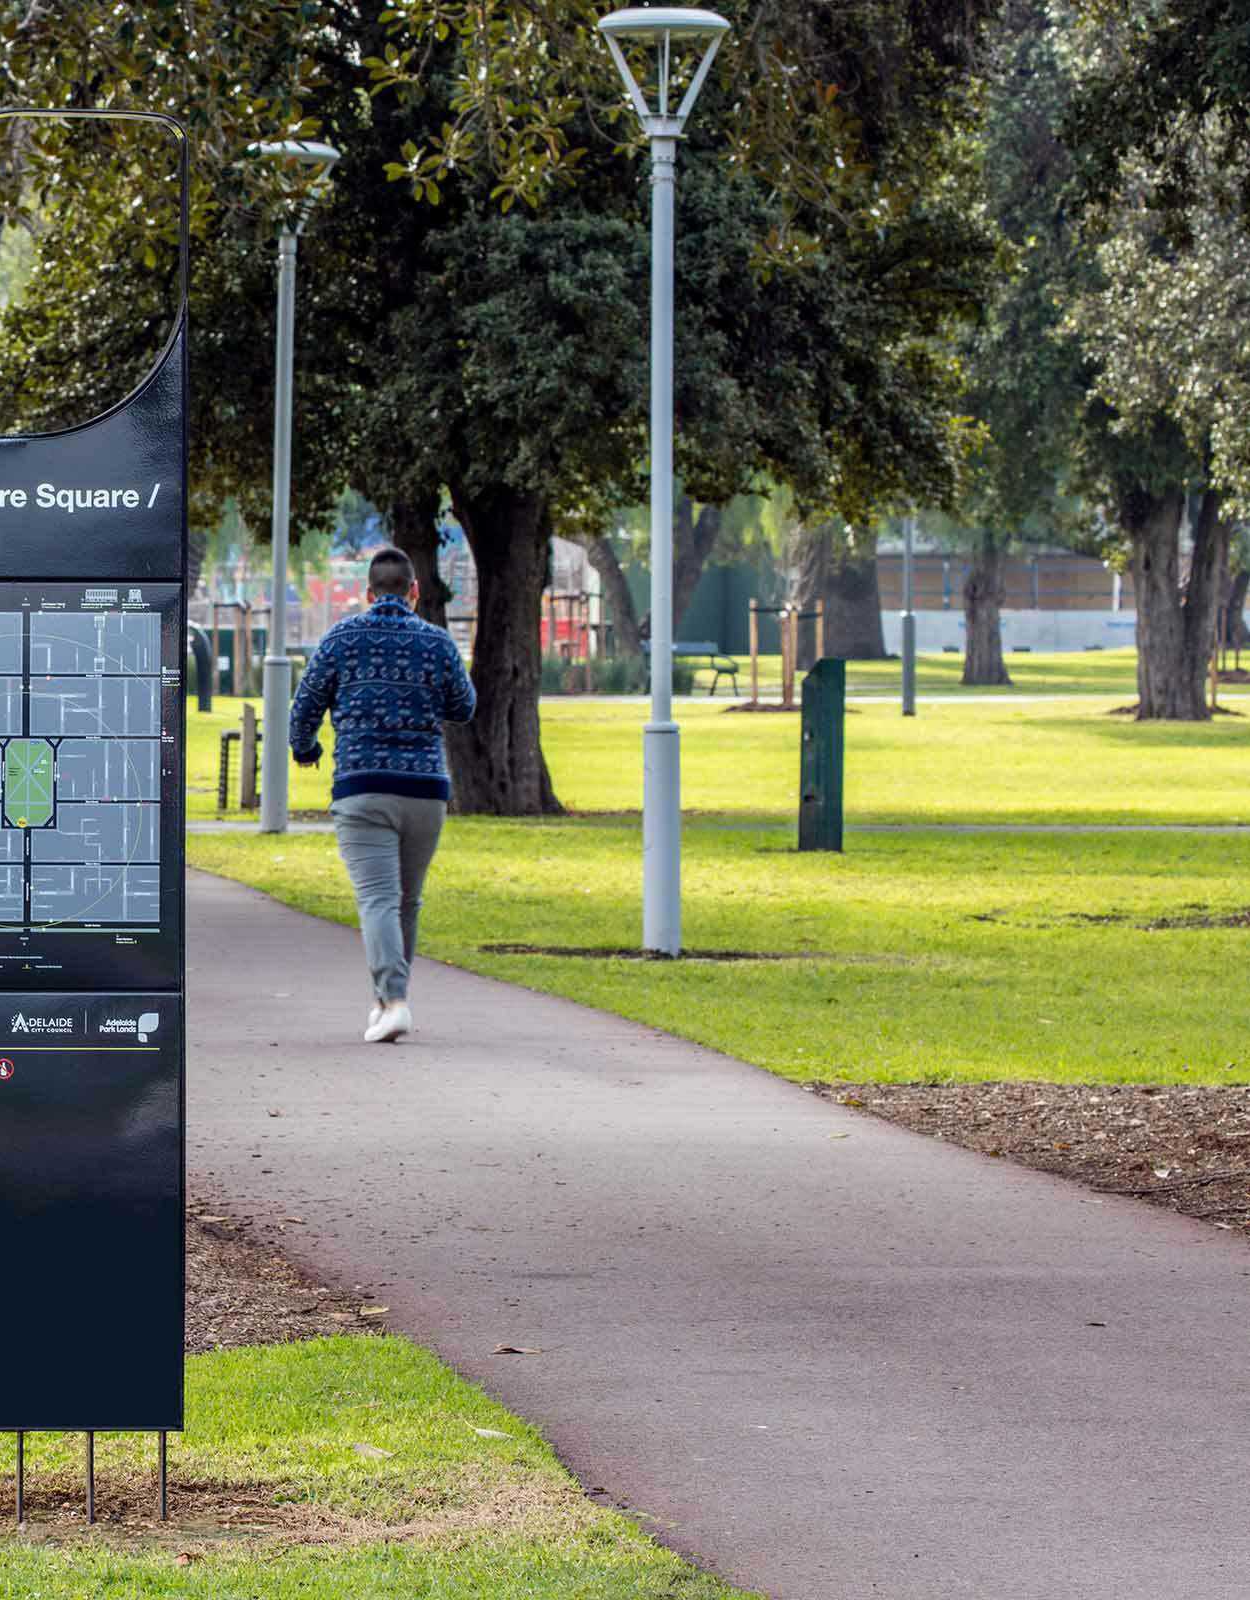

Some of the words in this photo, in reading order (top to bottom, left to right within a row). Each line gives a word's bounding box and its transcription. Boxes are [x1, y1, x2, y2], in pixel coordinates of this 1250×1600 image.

[36, 484, 139, 513] Square
[147, 484, 161, 509] /
[11, 1012, 73, 1033] ADELAIDE
[99, 1025, 116, 1033] Park
[116, 1025, 137, 1033] Lands
